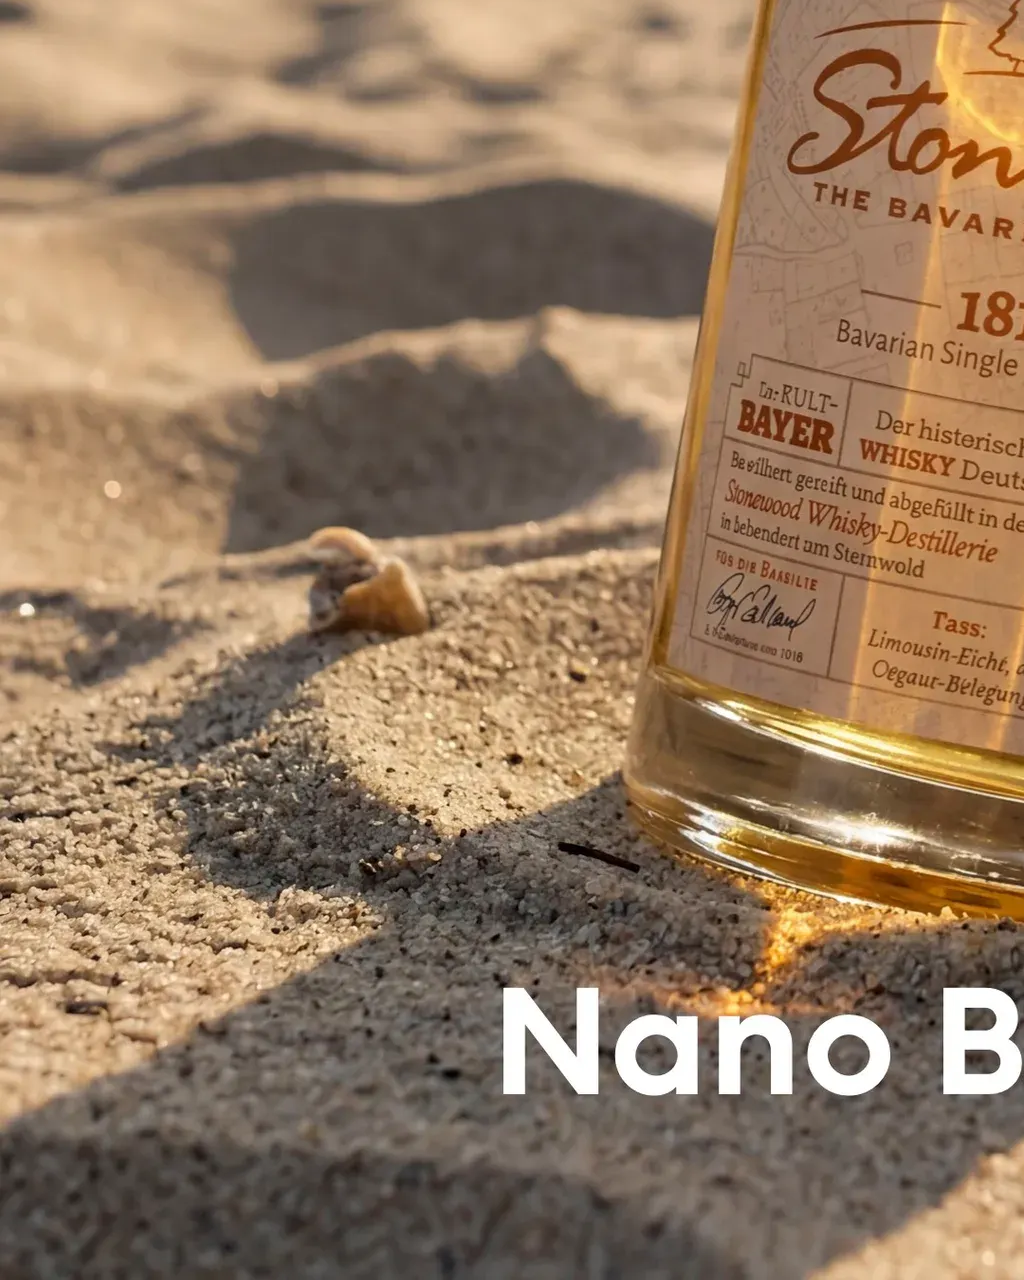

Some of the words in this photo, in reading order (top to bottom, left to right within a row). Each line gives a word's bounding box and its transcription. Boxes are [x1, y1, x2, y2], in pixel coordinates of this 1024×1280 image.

[813, 181, 871, 212] THE
[835, 318, 935, 362] Bavarian
[940, 339, 1019, 379] Single
[736, 398, 836, 456] BAYER
[875, 409, 916, 437] Der
[859, 437, 957, 477] WHISKY
[720, 511, 732, 531] in
[724, 478, 805, 521] Stonewood
[808, 499, 1000, 564] Whisky-Destillerie
[794, 473, 848, 498] gereift
[851, 483, 886, 507] und
[979, 508, 999, 529] in
